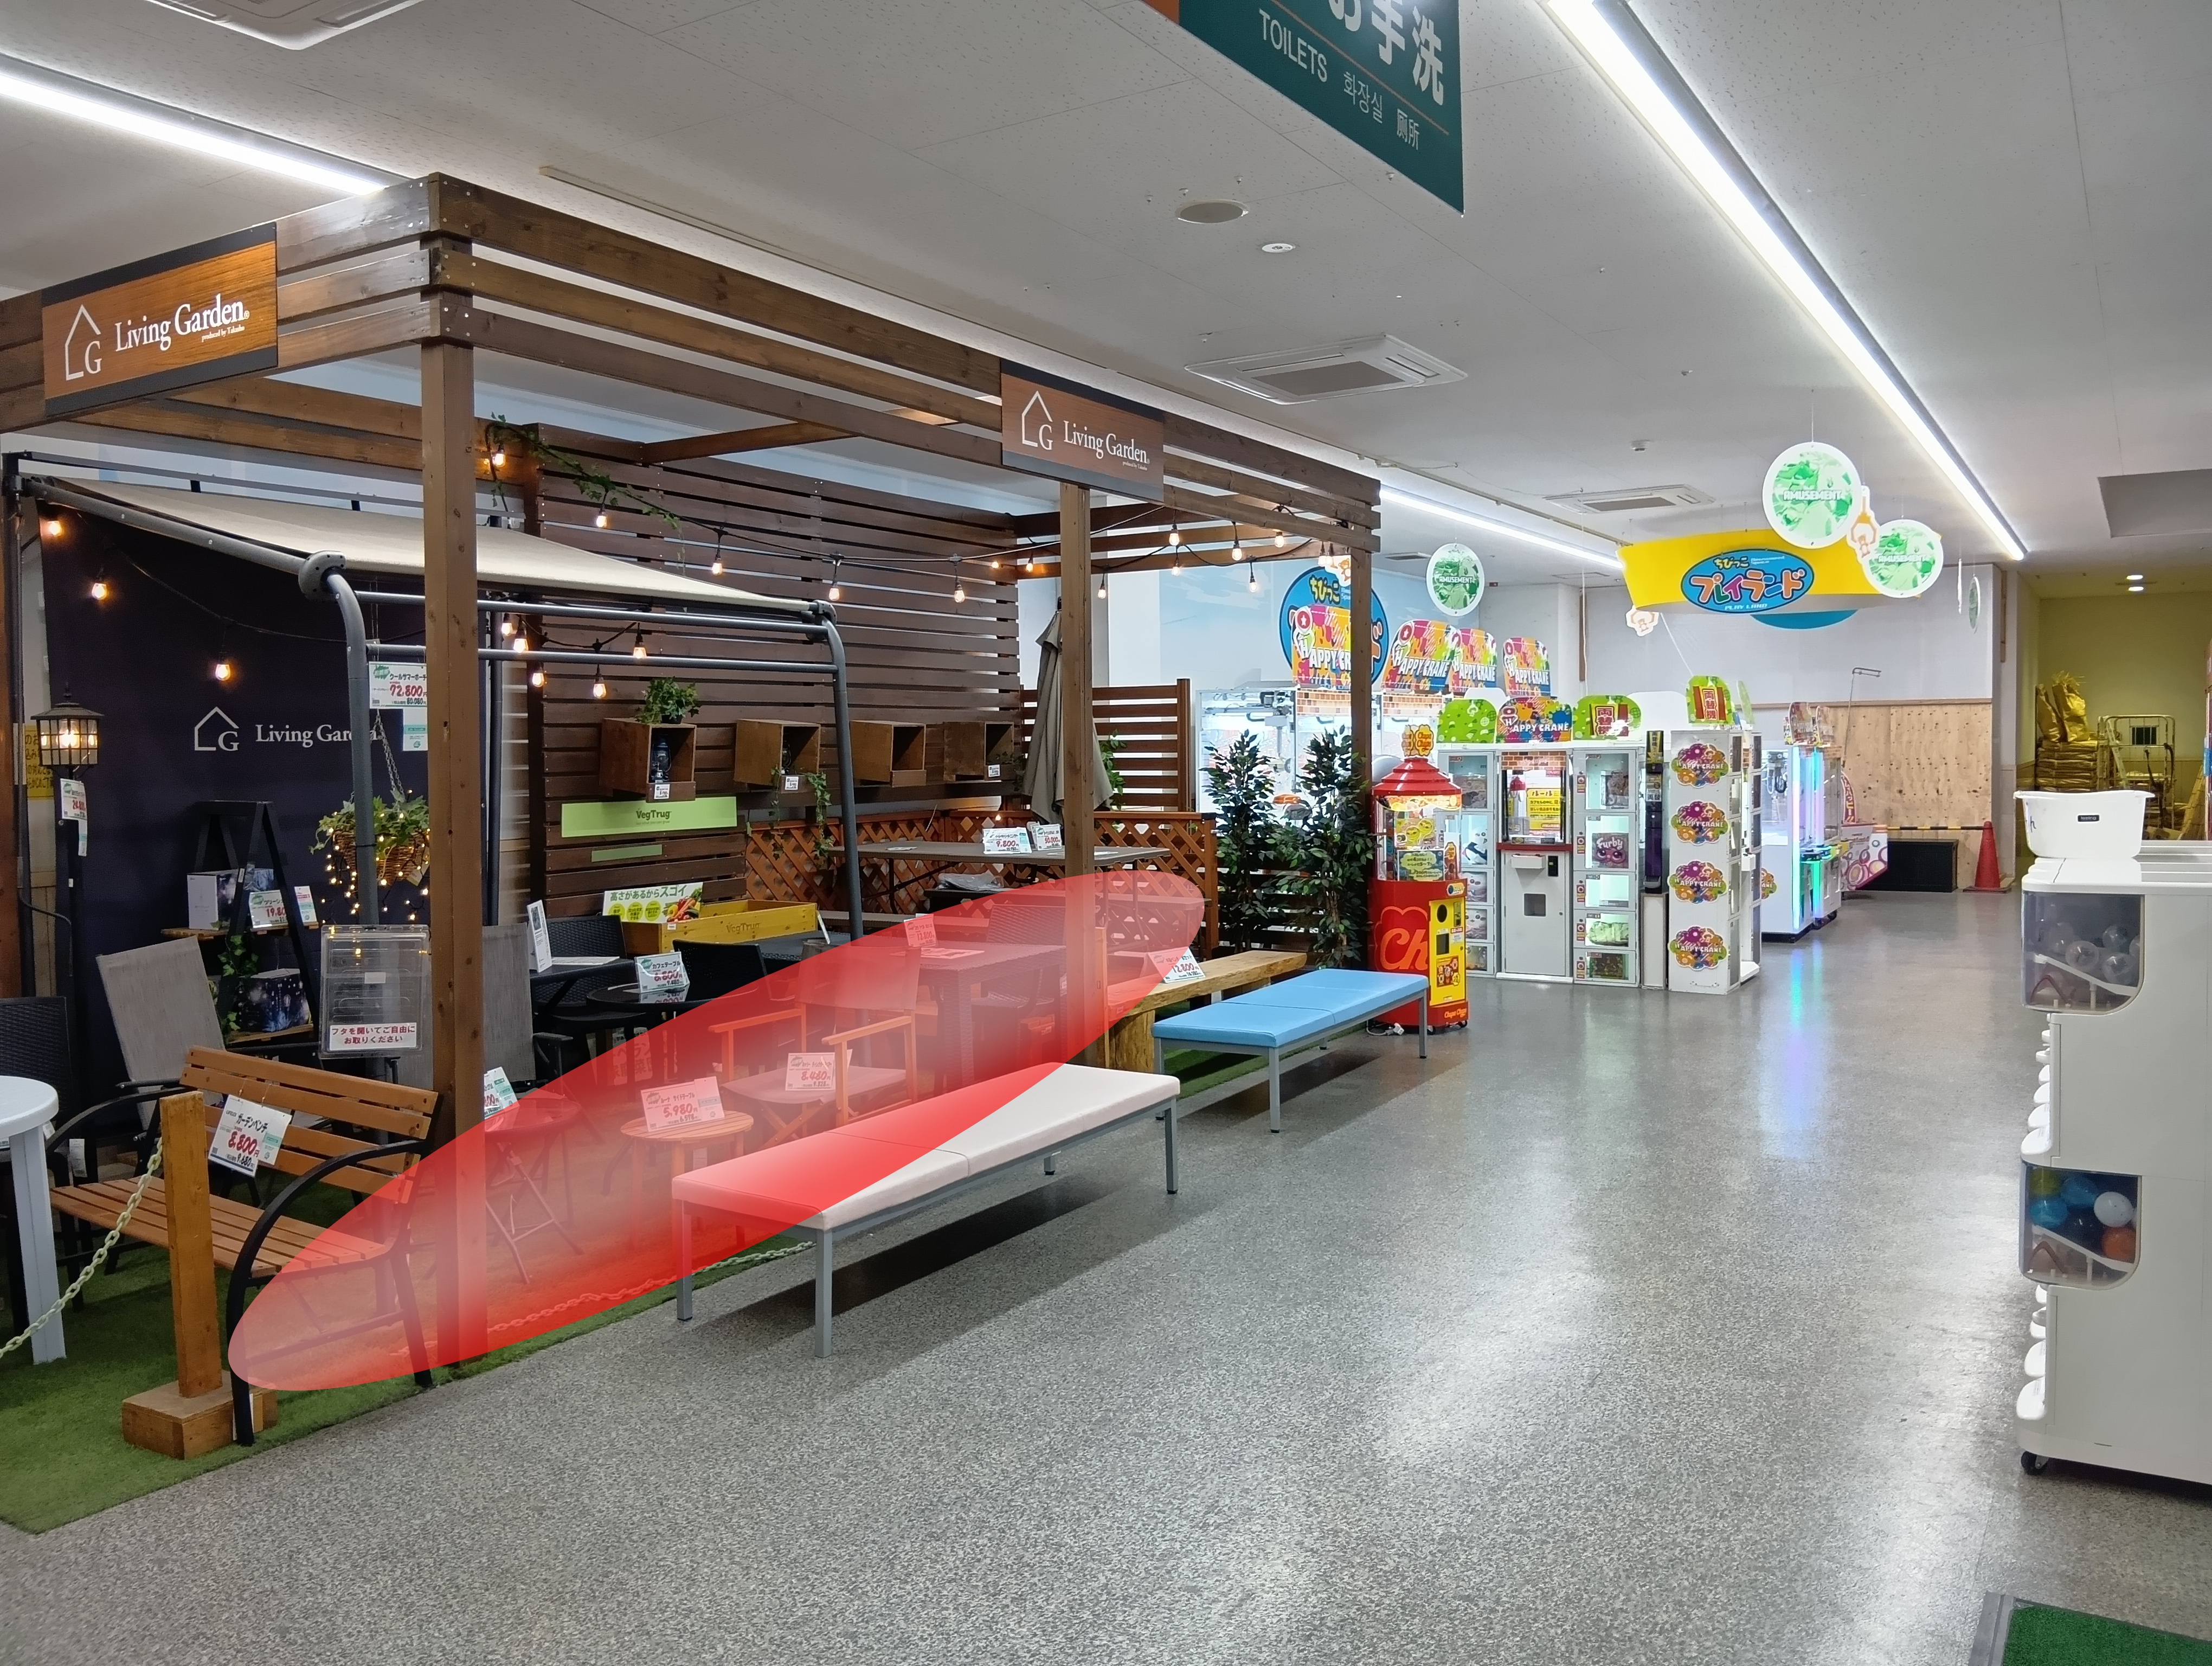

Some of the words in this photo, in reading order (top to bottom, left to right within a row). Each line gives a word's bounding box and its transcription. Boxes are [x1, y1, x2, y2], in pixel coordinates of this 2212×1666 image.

[1259, 9, 1328, 82] TOILETS
[1343, 71, 1383, 124] 화장실
[115, 316, 171, 351] Living
[1063, 420, 1104, 459] Living
[1783, 490, 1842, 501] AMUSEMENT
[1714, 556, 1749, 569] ちびっこ
[1309, 575, 1340, 604] ちびっこ
[1690, 568, 1806, 604] プレイランド
[1422, 661, 1450, 678] CRANE
[1477, 664, 1496, 682] CRANE
[1532, 671, 1549, 685] CRANE
[1704, 690, 1718, 720] 両替機
[1539, 723, 1568, 732] CRANE
[255, 725, 313, 748] Living
[636, 810, 671, 821] VegTrug
[1596, 837, 1623, 850] Furby
[610, 885, 687, 902] 高さがあるからスゴイ
[652, 960, 681, 969] カフェテーブル
[332, 1025, 415, 1035] フタを開いてご自由に
[344, 1035, 403, 1044] お取りください
